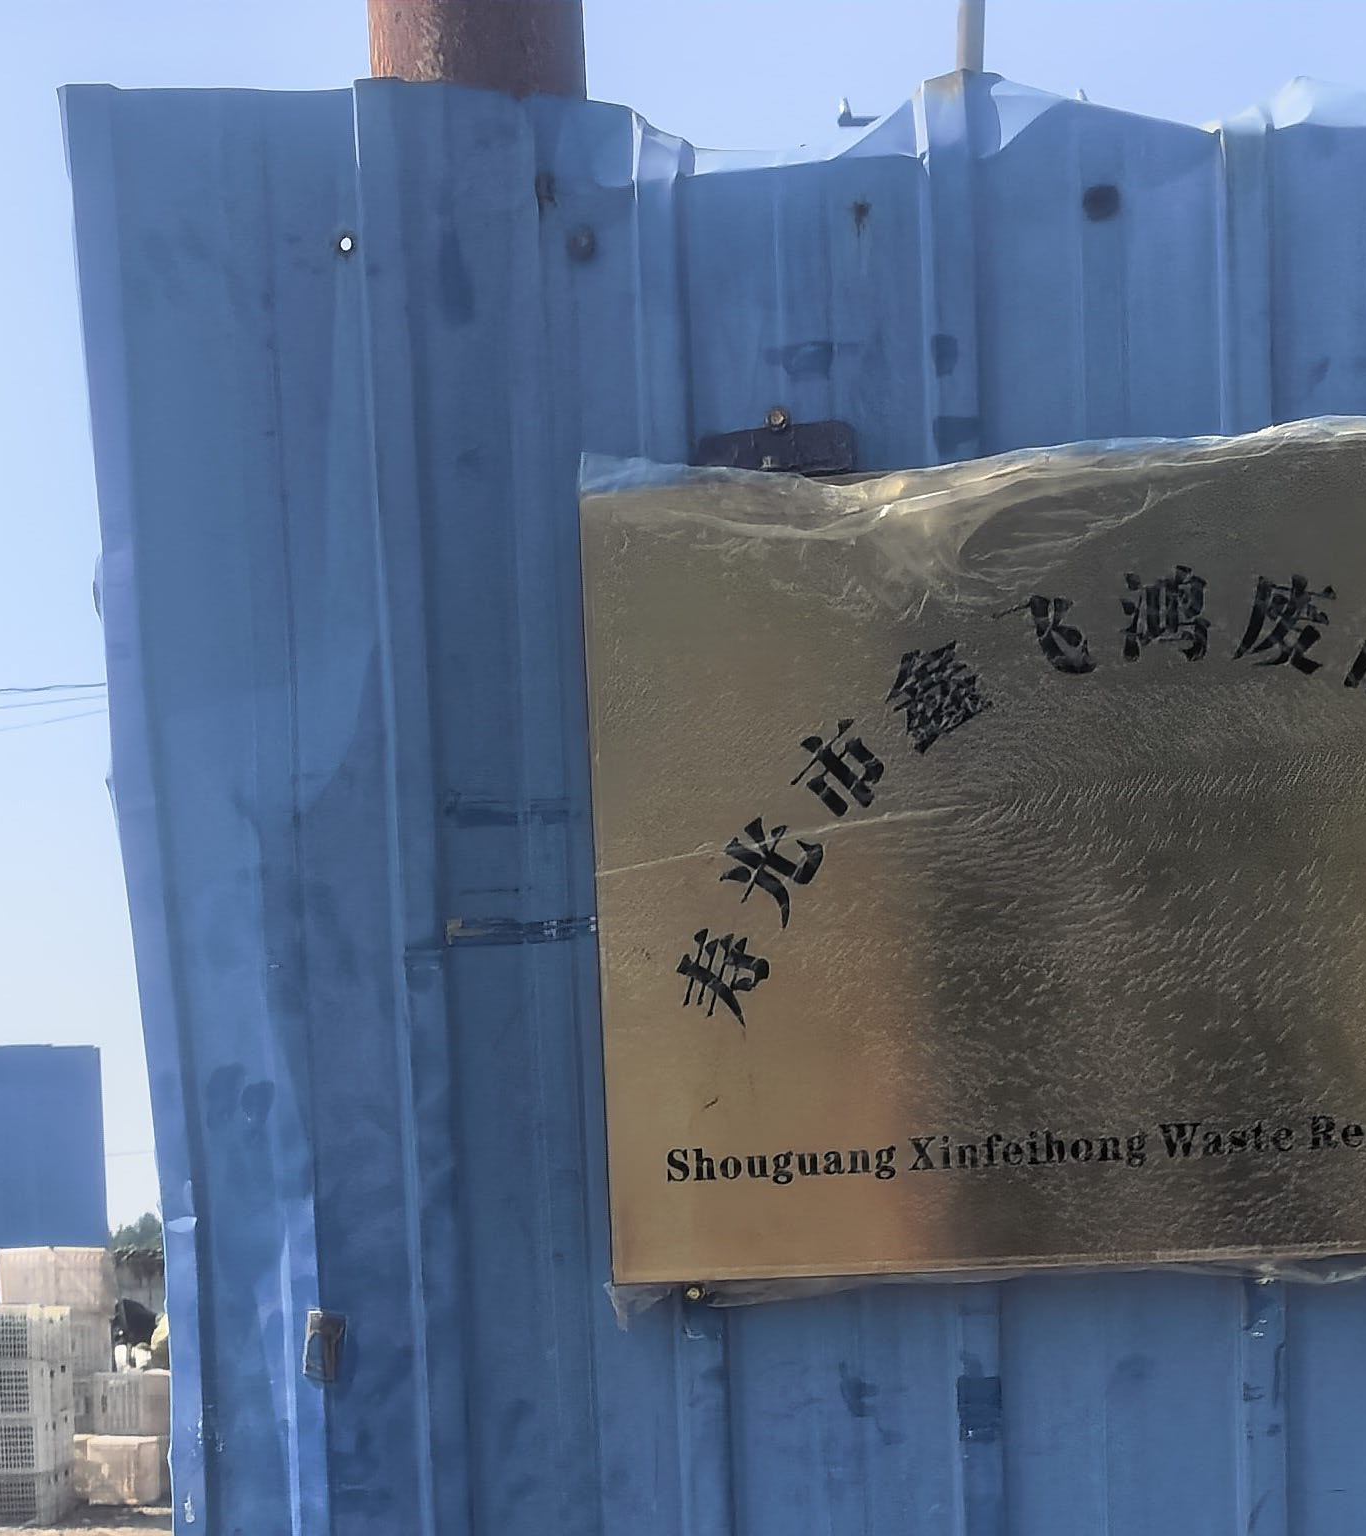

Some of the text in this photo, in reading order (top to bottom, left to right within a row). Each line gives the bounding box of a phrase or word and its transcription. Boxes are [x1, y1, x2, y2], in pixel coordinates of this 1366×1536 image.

[666, 1144, 896, 1185] Shouguang
[908, 1130, 1147, 1171] Xinfeihong
[1159, 1120, 1294, 1161] Waste
